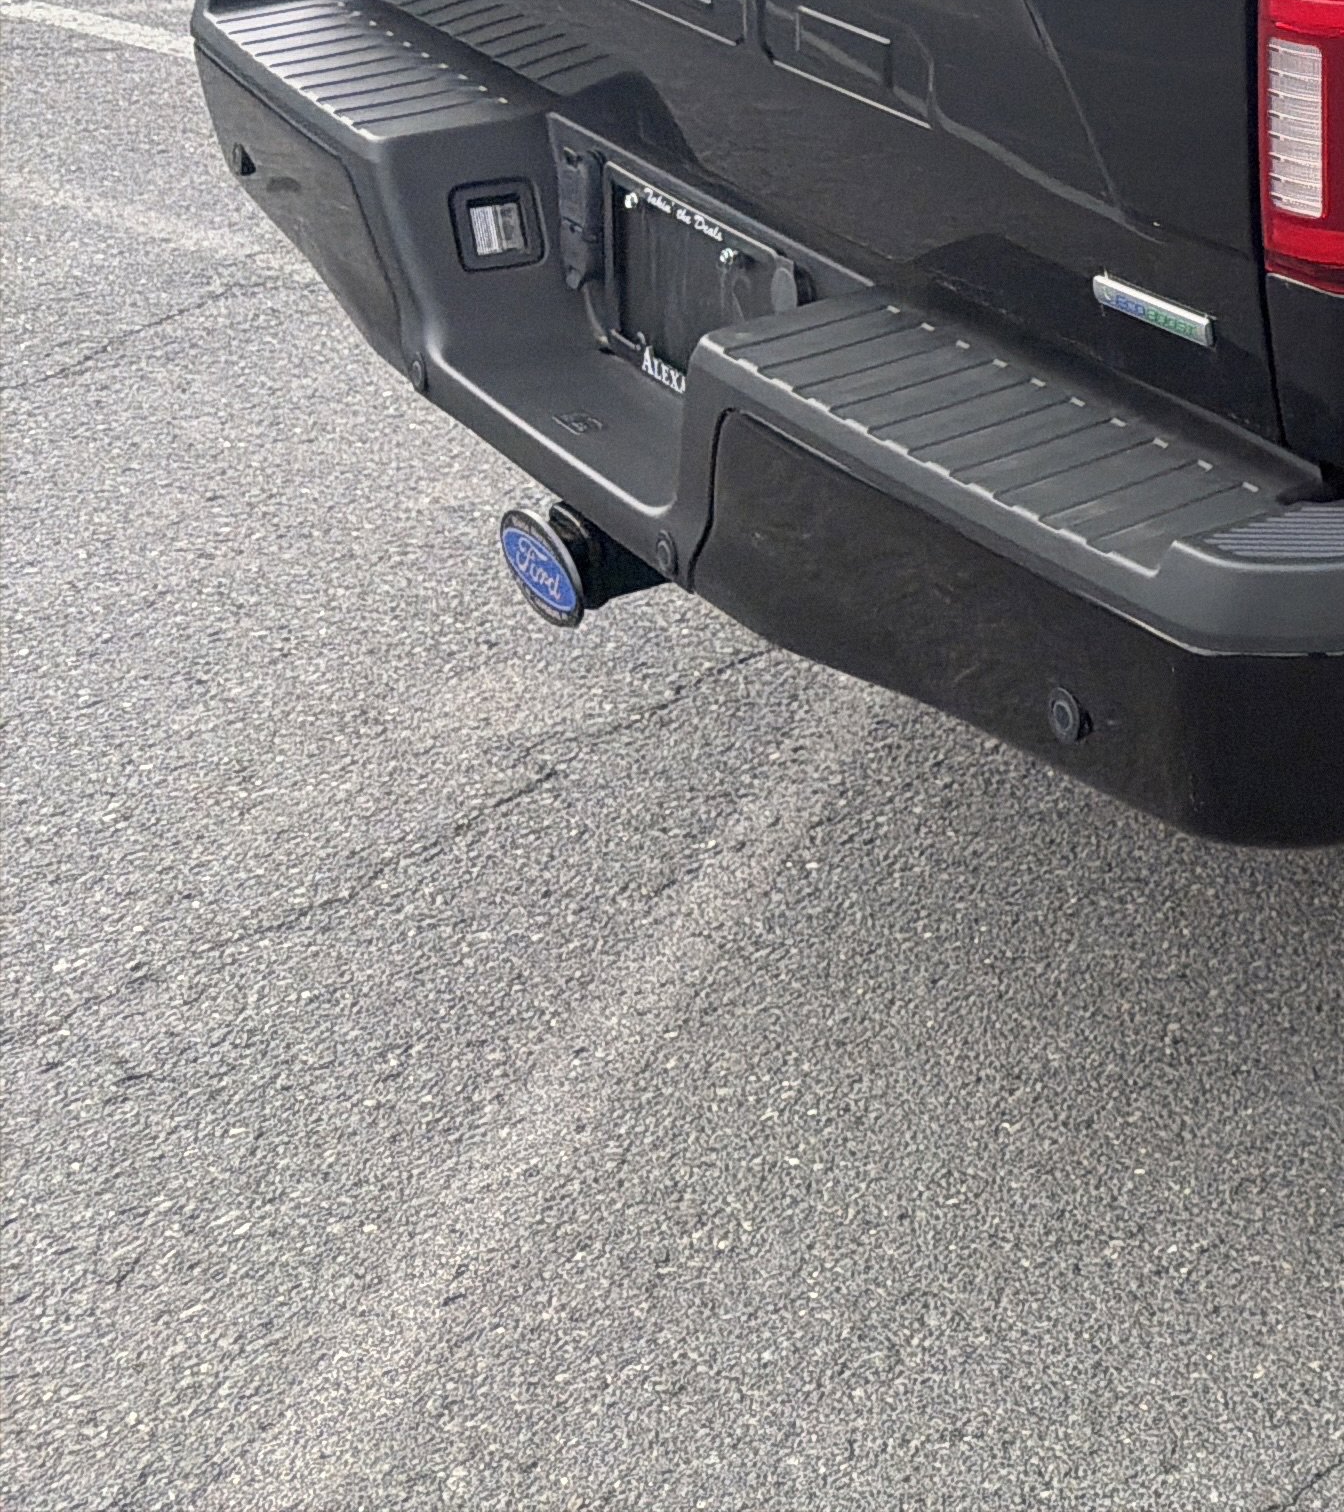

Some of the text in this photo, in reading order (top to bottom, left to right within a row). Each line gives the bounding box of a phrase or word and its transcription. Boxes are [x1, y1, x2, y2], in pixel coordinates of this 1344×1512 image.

[676, 208, 692, 225] the
[693, 214, 723, 242] Deals
[516, 536, 562, 600] Ford
